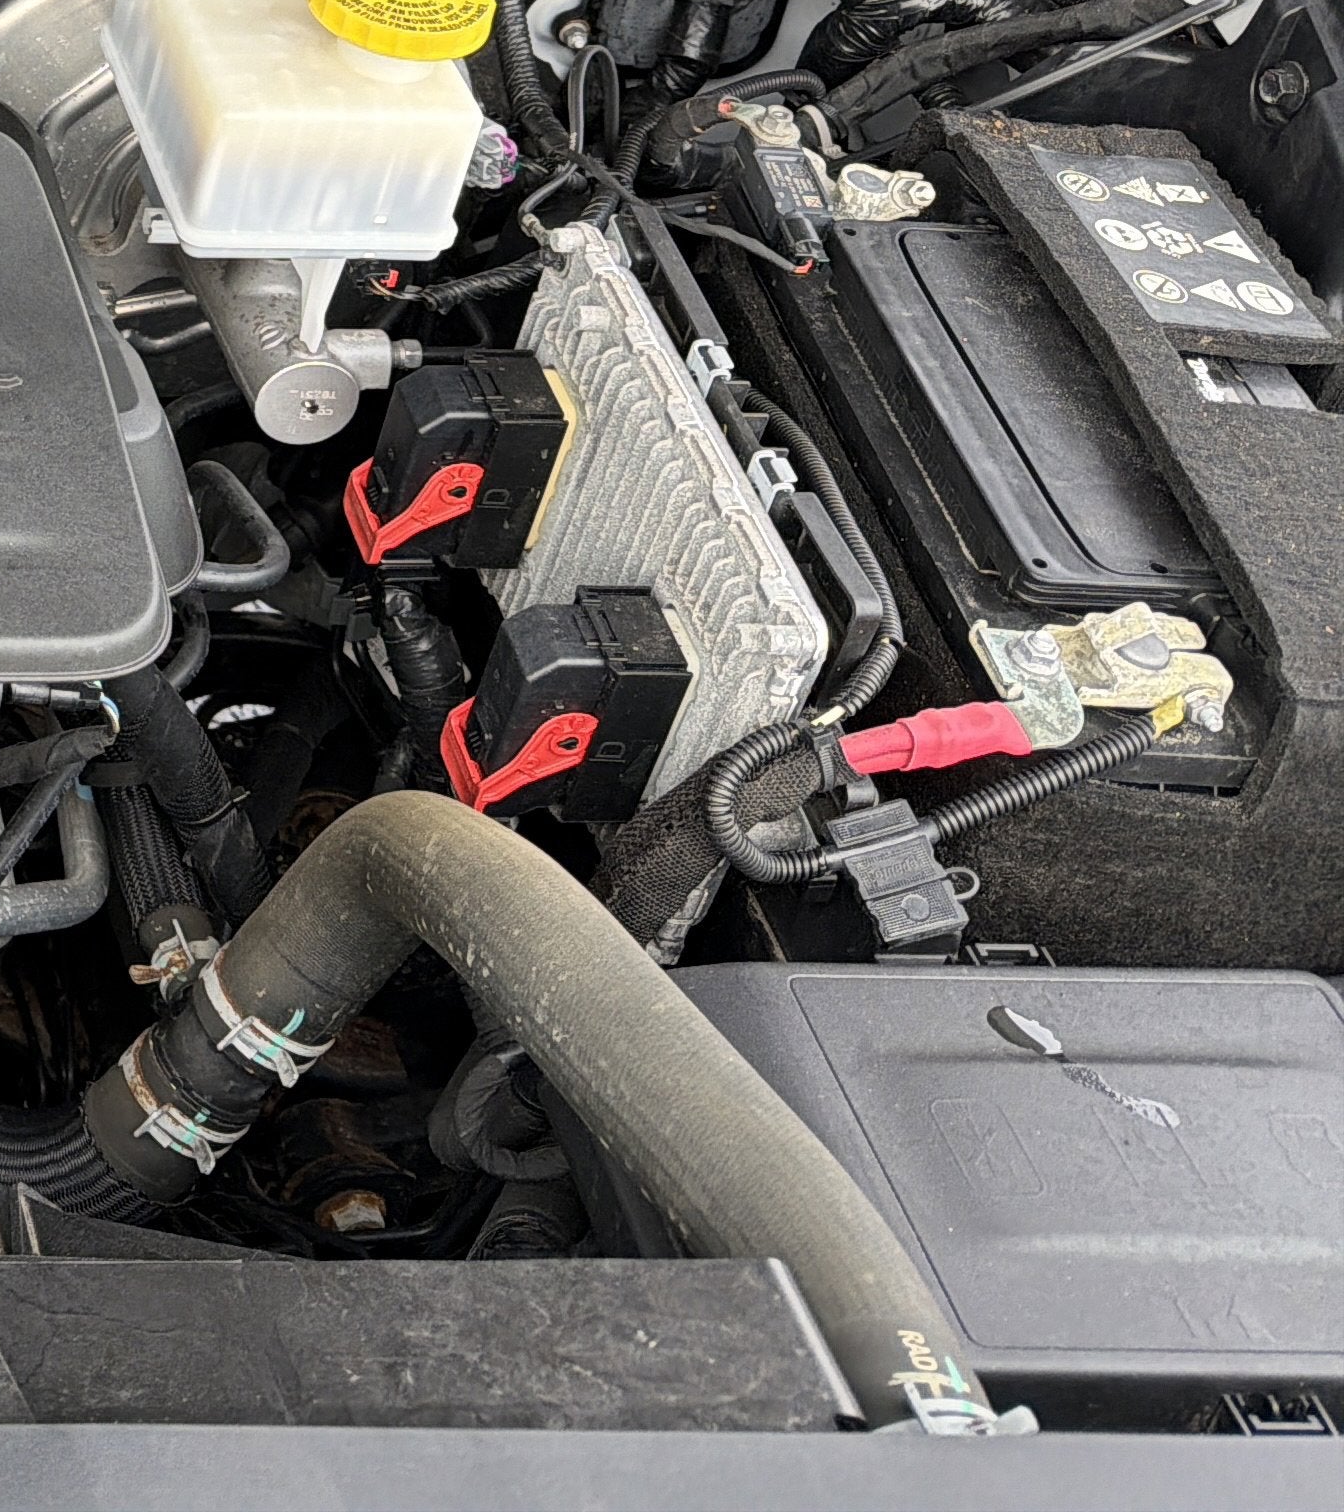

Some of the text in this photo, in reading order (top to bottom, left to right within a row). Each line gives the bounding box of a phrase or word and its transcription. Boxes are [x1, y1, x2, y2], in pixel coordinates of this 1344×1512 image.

[373, 2, 454, 17] CLEAN FILLER CAP
[360, 12, 387, 24] FLUID
[388, 21, 417, 31] FROM
[427, 23, 461, 32] SEALED
[897, 1329, 939, 1371] RAD
